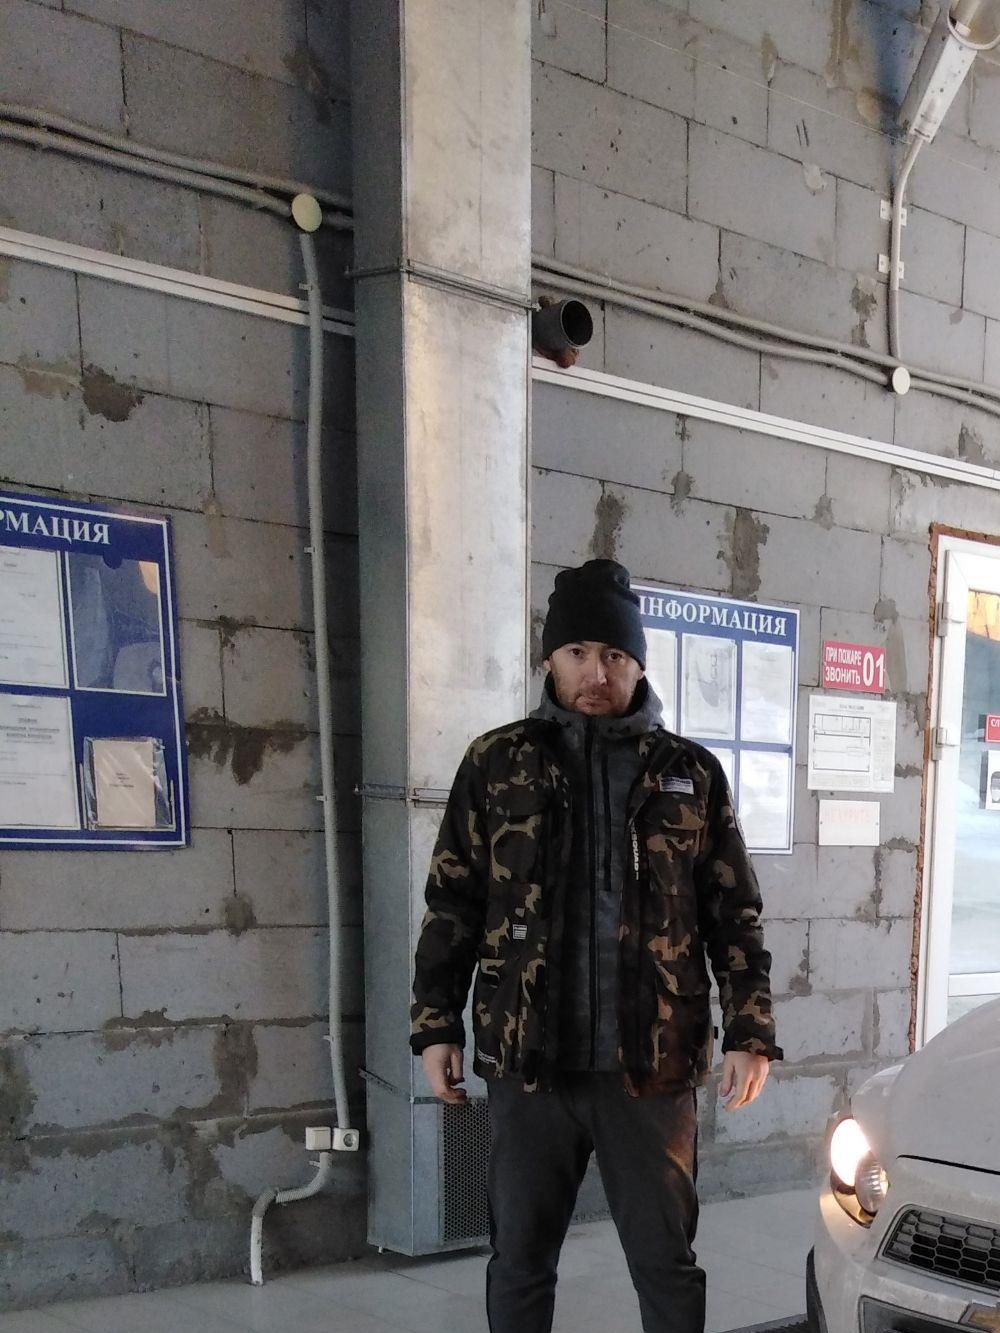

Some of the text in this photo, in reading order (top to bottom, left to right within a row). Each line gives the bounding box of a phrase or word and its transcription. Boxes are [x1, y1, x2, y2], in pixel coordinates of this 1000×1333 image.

[825, 646, 862, 666] ПРИ ПОЖАРЕ
[825, 666, 861, 685] ЗВОНИТЬ
[862, 652, 884, 688] 01
